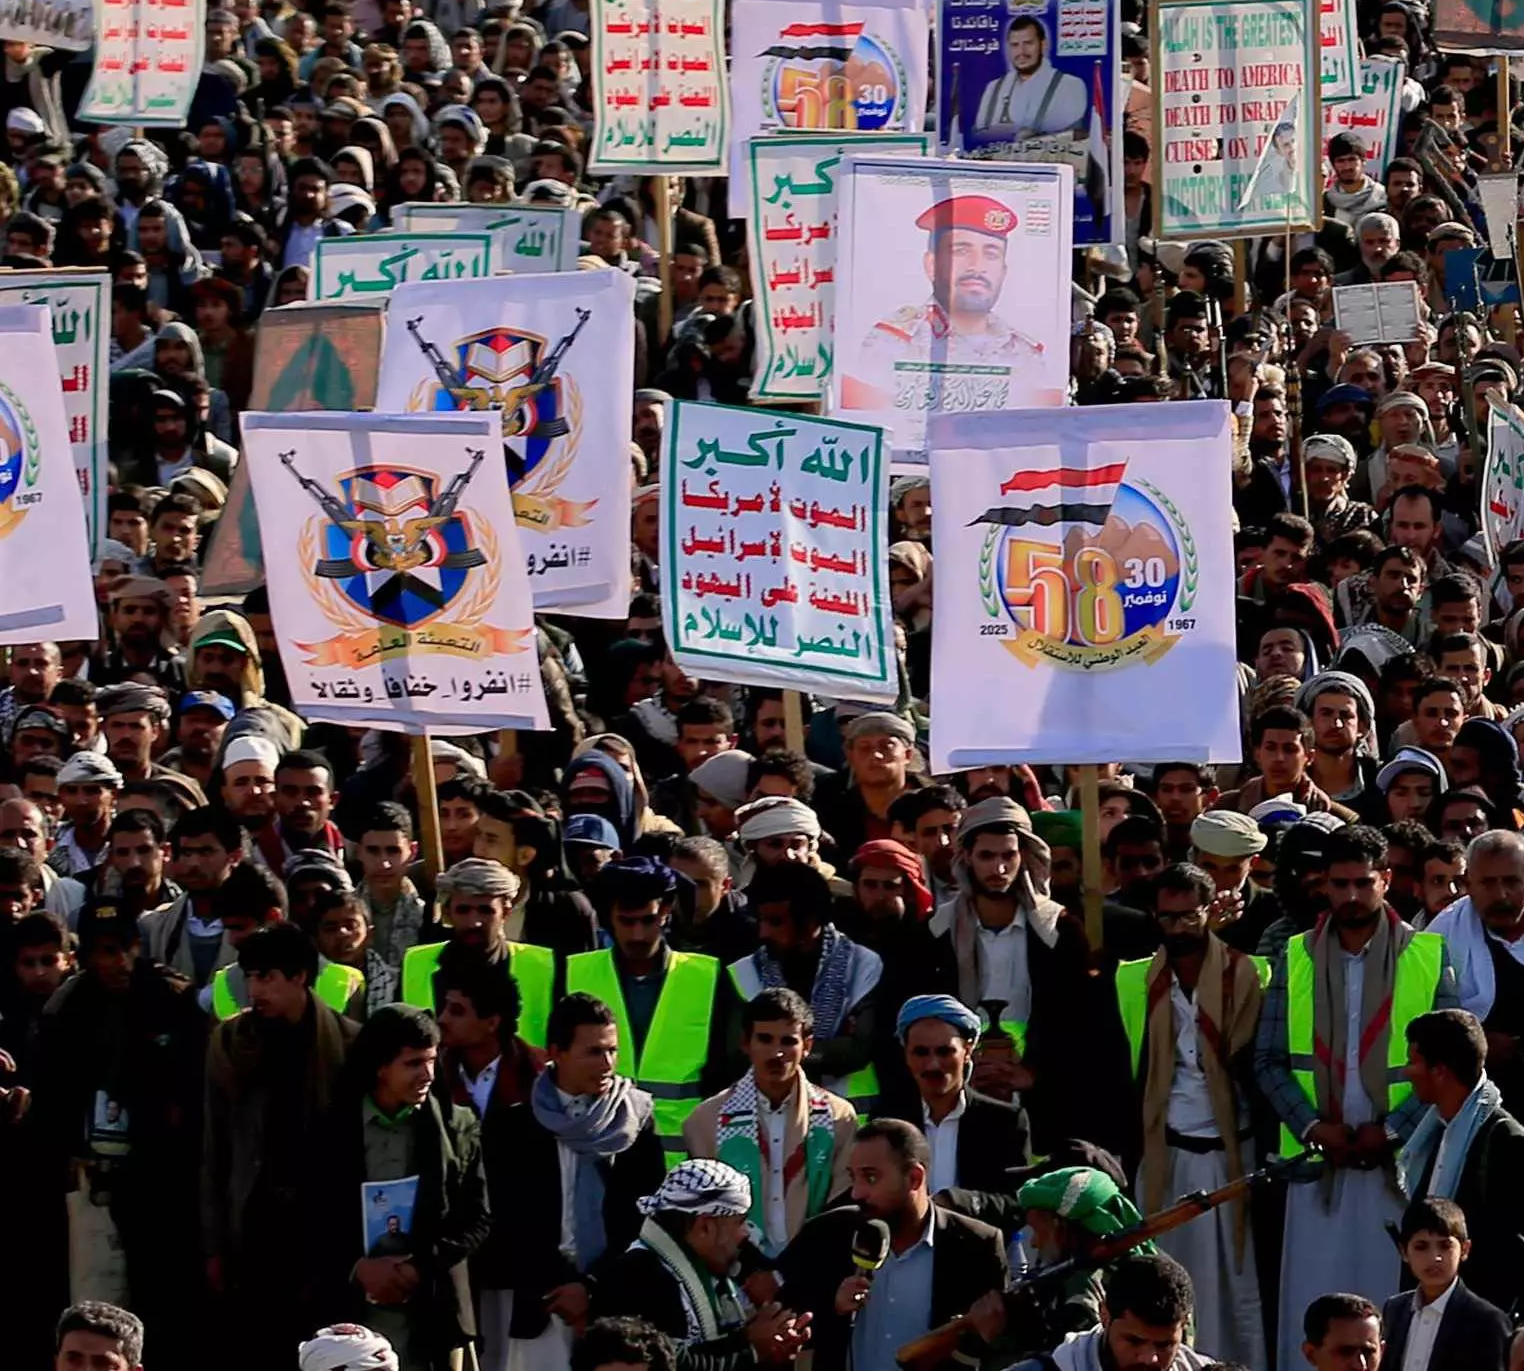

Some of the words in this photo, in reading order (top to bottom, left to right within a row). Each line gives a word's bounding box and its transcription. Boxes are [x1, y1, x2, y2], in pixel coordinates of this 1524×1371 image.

[1200, 17, 1213, 49] IS
[1216, 15, 1237, 49] THE
[1165, 68, 1209, 92] DEATH
[1216, 69, 1234, 87] TO
[1242, 64, 1302, 87] AMERICA
[1165, 105, 1211, 126] DEATH
[1217, 105, 1237, 124] TO
[1230, 138, 1248, 160] ON
[680, 420, 797, 476] أكبر
[800, 436, 869, 484] الله
[683, 479, 781, 516] لأمريكا
[791, 497, 866, 532] الموت
[684, 526, 781, 564] لإسرائيل
[791, 542, 864, 574] الموت
[683, 570, 750, 601] اليهود
[763, 576, 798, 607] على
[810, 583, 868, 615] اللعنة
[1005, 539, 1125, 647] 58
[1124, 558, 1165, 588] 30
[1124, 592, 1167, 608] نوفمبر
[418, 632, 481, 653] التعبئة
[685, 606, 778, 654] للإسلام
[792, 624, 871, 658] النصر
[980, 625, 1008, 636] 2025
[1169, 619, 1196, 630] 1967
[356, 633, 411, 662] العامة
[1084, 649, 1123, 670] الوطني
[1126, 635, 1150, 656] العيد
